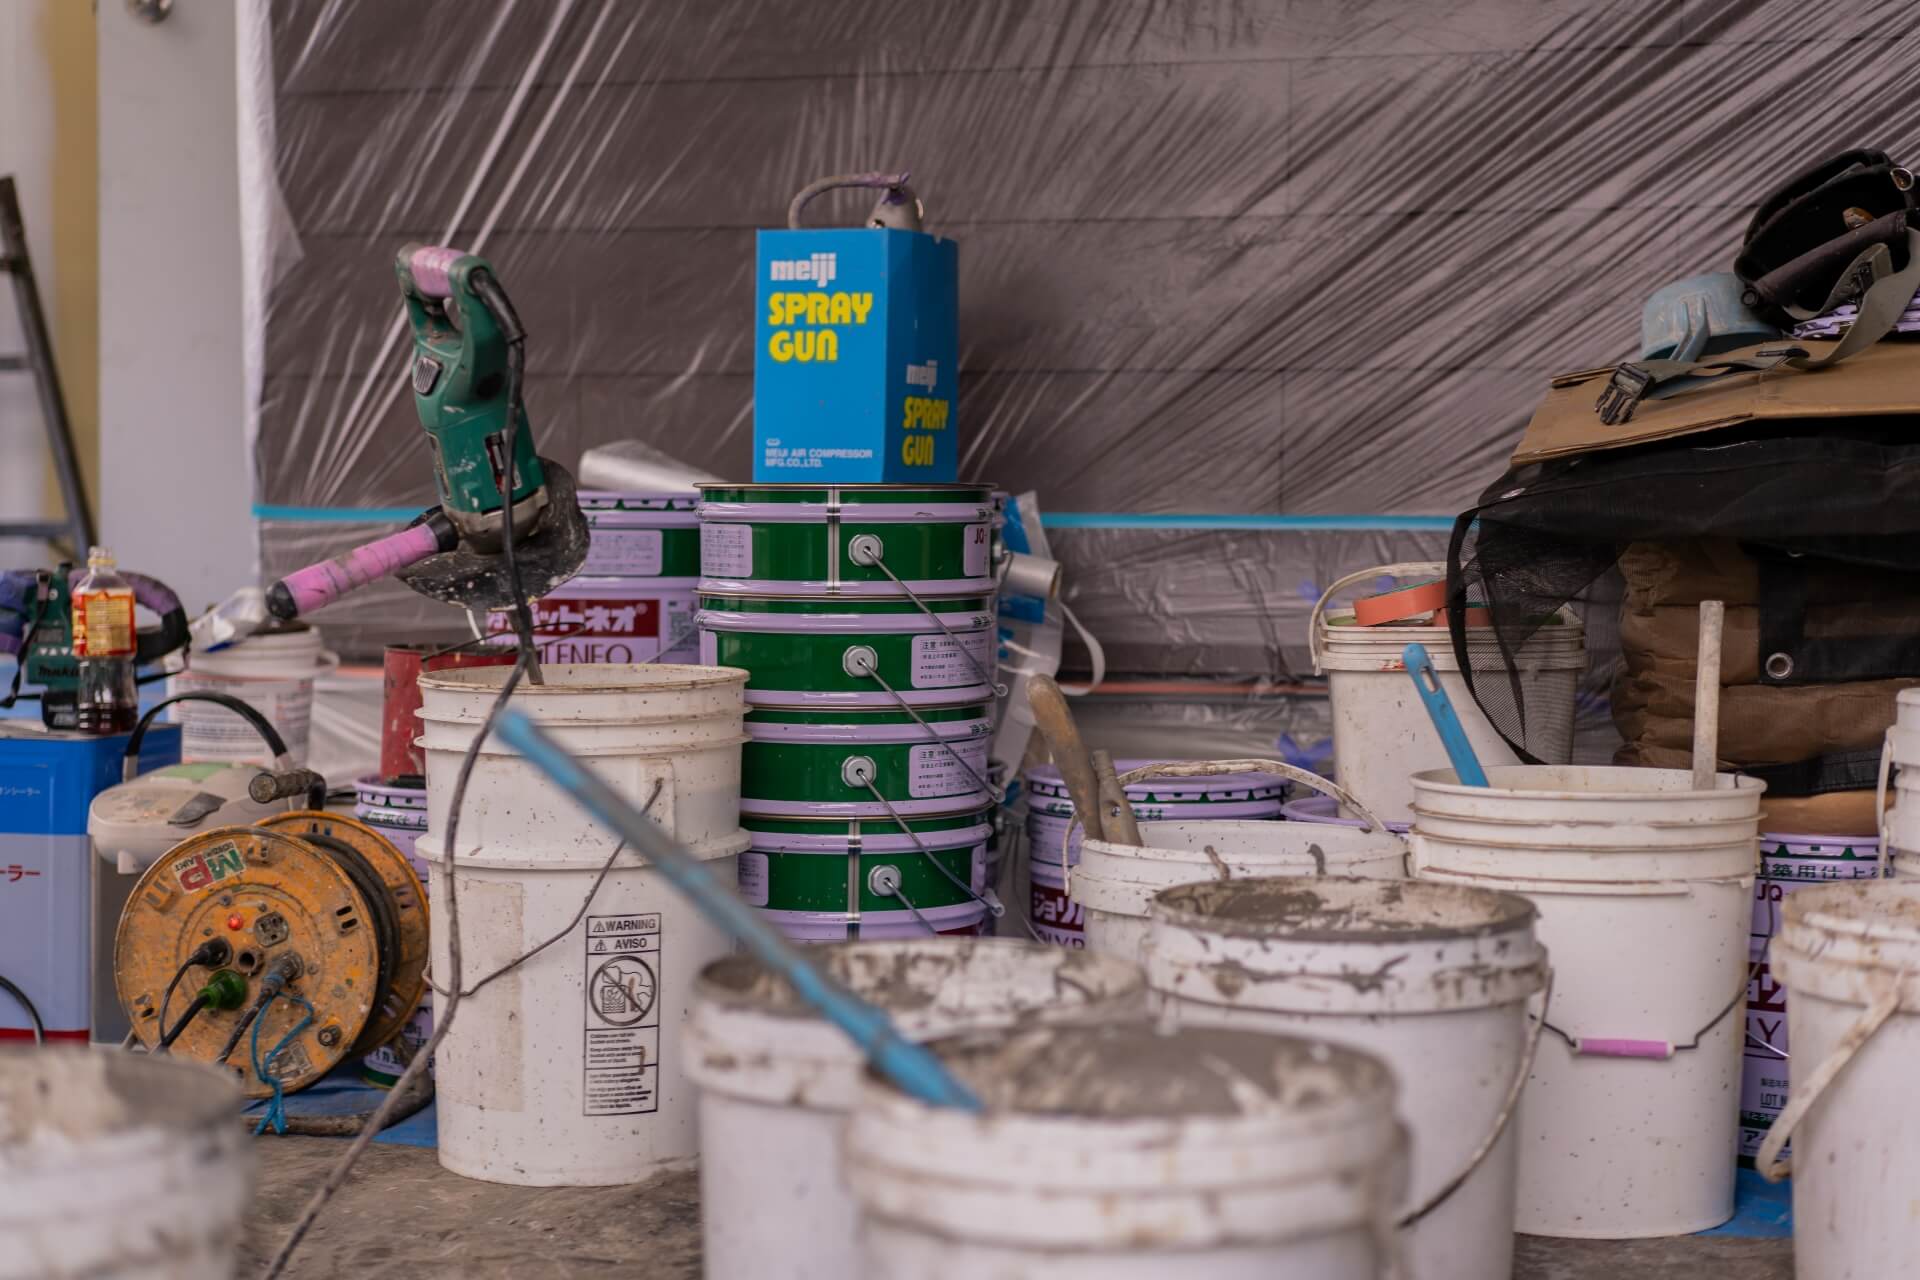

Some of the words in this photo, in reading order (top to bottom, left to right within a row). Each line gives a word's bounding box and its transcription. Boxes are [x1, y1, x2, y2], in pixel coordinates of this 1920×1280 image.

[770, 252, 836, 287] meiji
[768, 292, 873, 325] SPRAY
[768, 329, 838, 363] GUN
[906, 360, 938, 393] meiji
[903, 396, 949, 430] SPRAY
[903, 434, 935, 466] GUN
[605, 918, 656, 931] WARNING
[613, 937, 648, 951] AVISO
